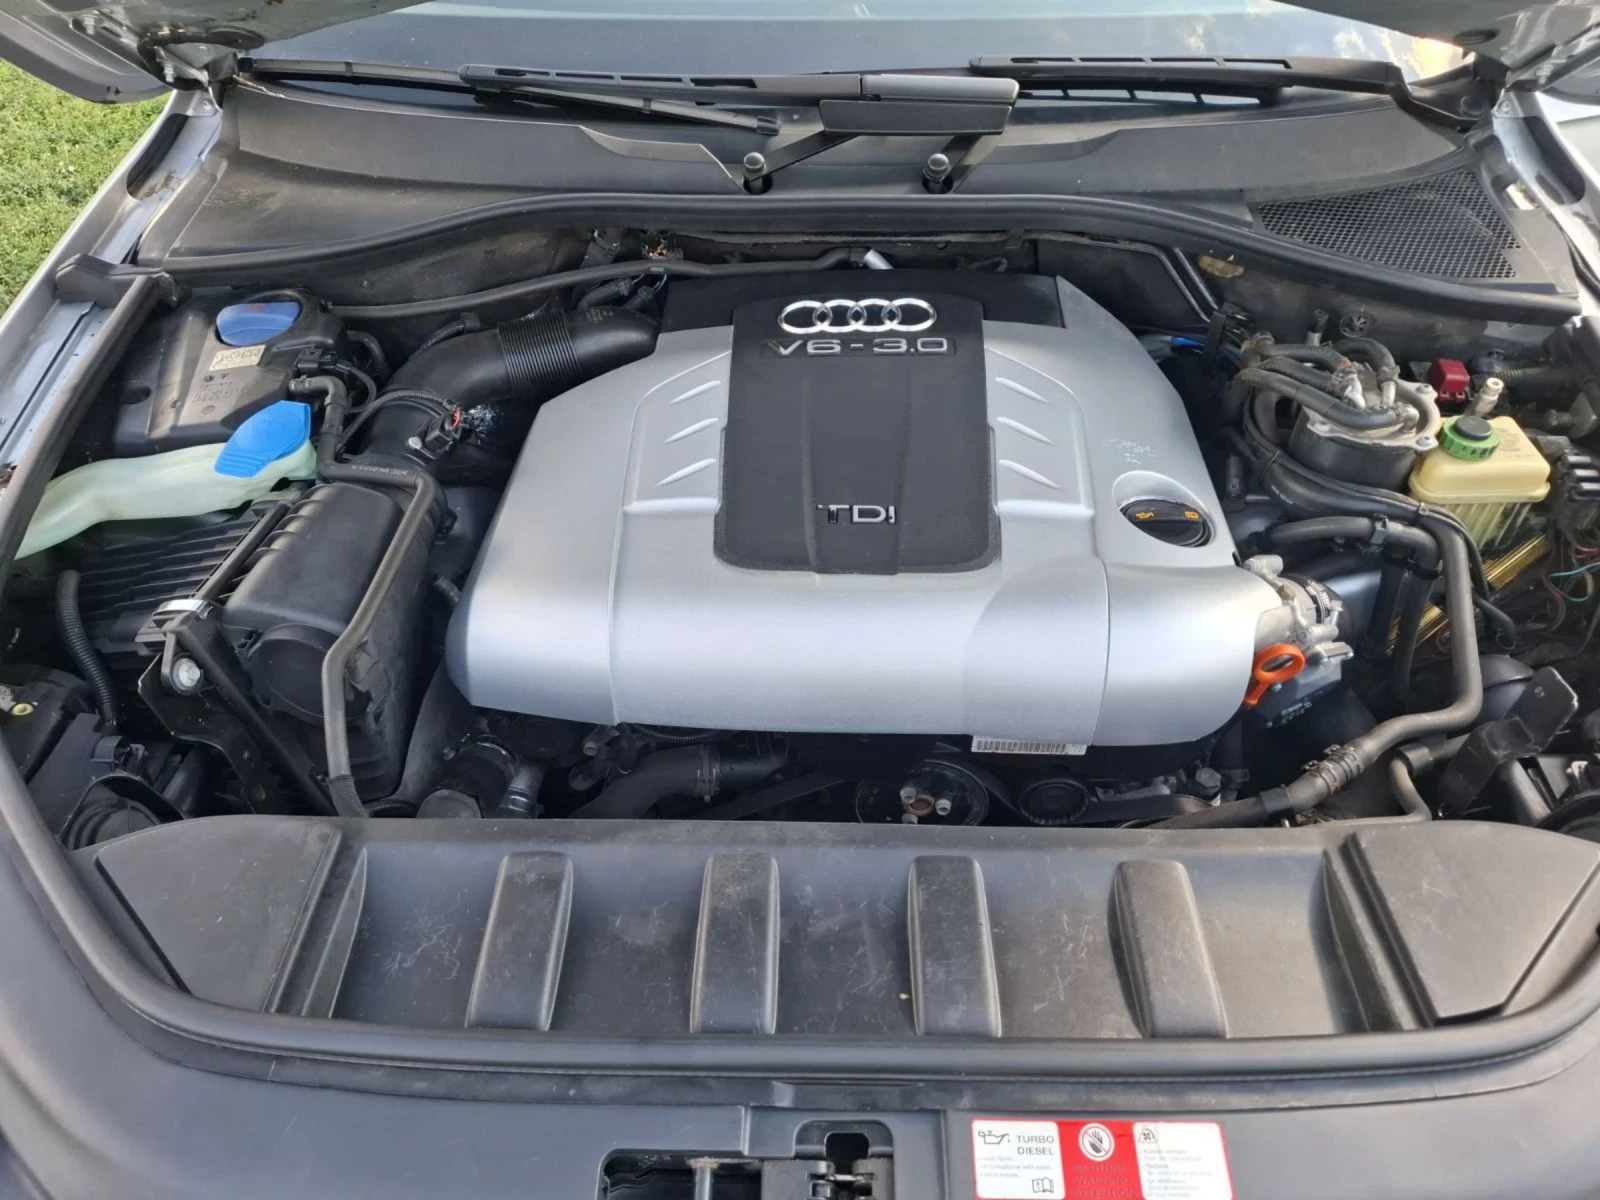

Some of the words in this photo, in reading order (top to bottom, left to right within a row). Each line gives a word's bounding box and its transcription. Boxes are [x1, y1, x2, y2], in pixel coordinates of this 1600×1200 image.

[816, 504, 896, 524] TDI
[1016, 1134, 1055, 1144] TURBO
[1017, 1146, 1055, 1155] DIESEL
